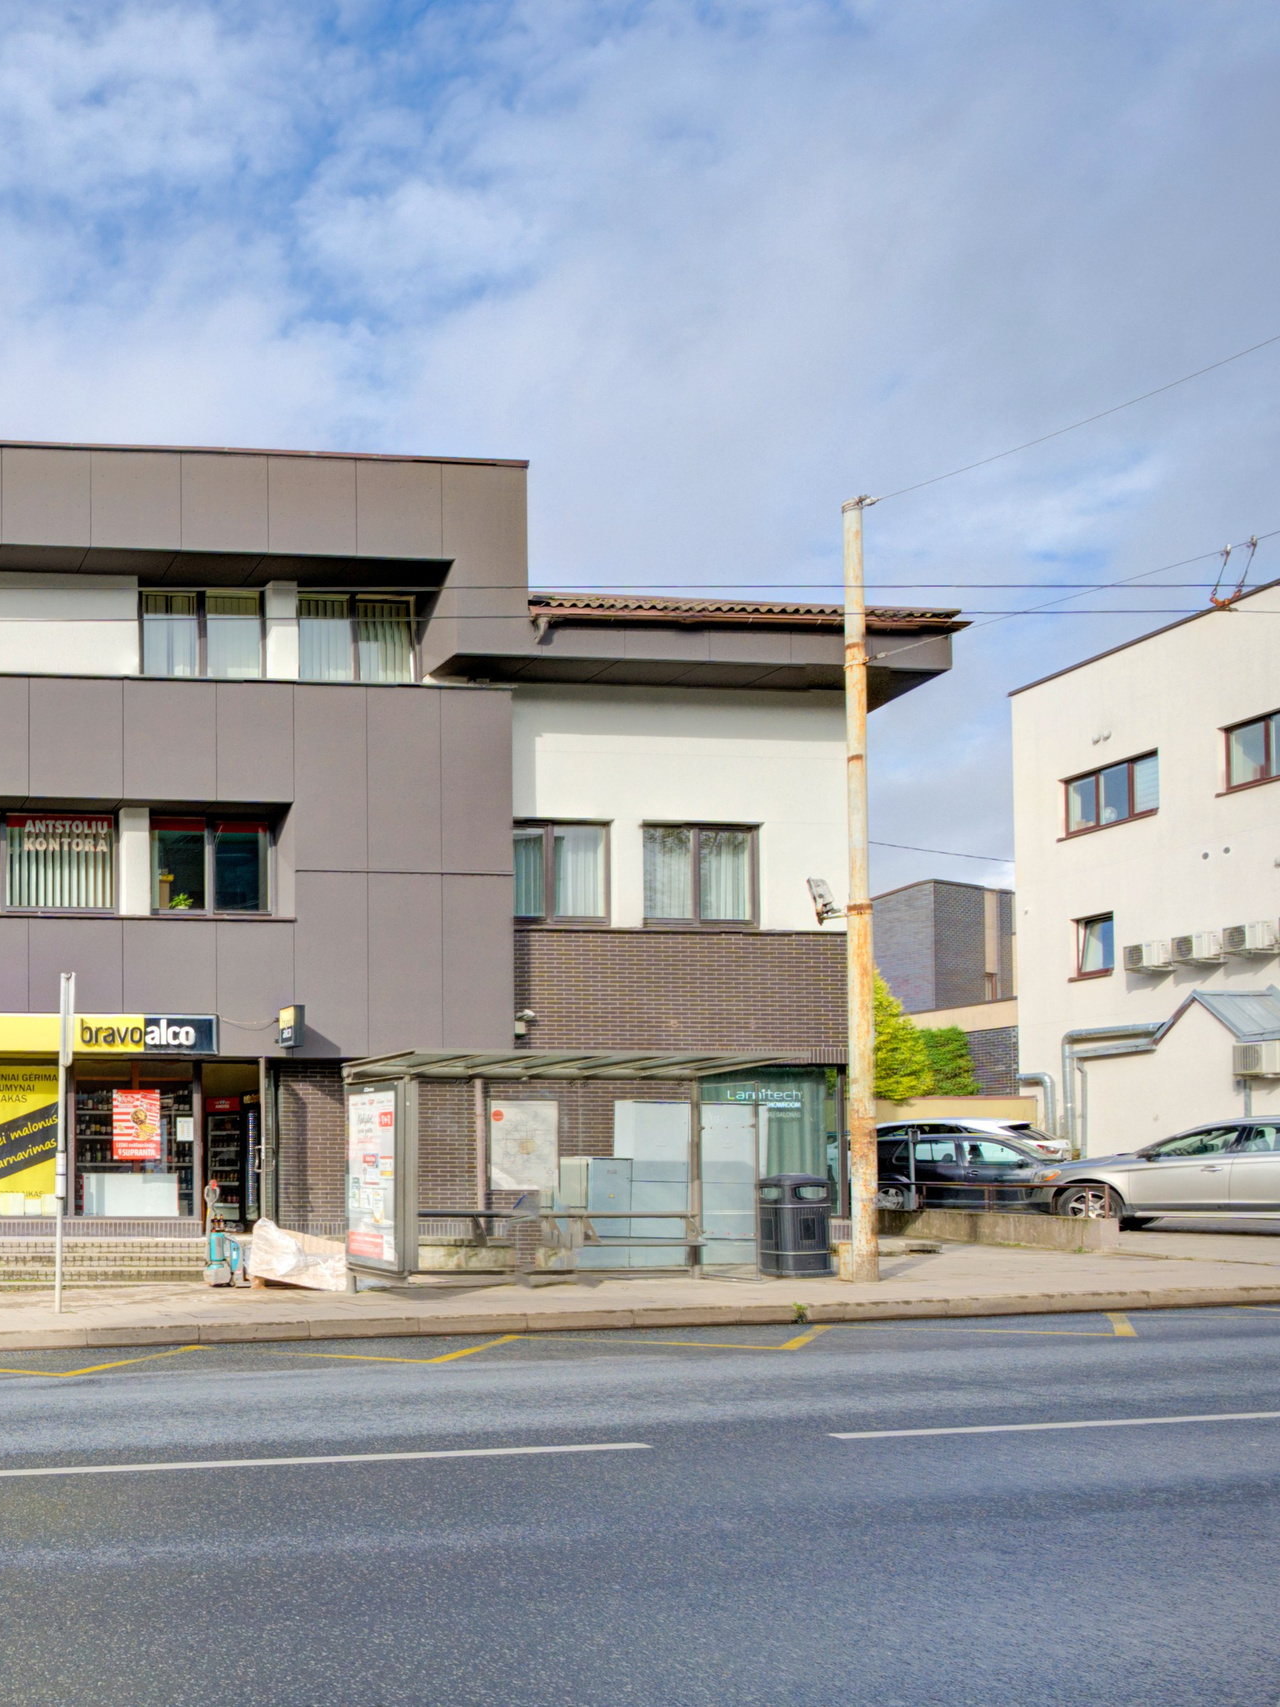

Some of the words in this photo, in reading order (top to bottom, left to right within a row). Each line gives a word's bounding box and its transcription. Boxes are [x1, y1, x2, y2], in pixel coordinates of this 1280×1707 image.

[24, 819, 108, 838] ANTSTOLIŲ
[23, 837, 108, 853] KONTORA
[21, 1072, 58, 1082] GĖRIMA
[10, 1114, 58, 1140] malonus
